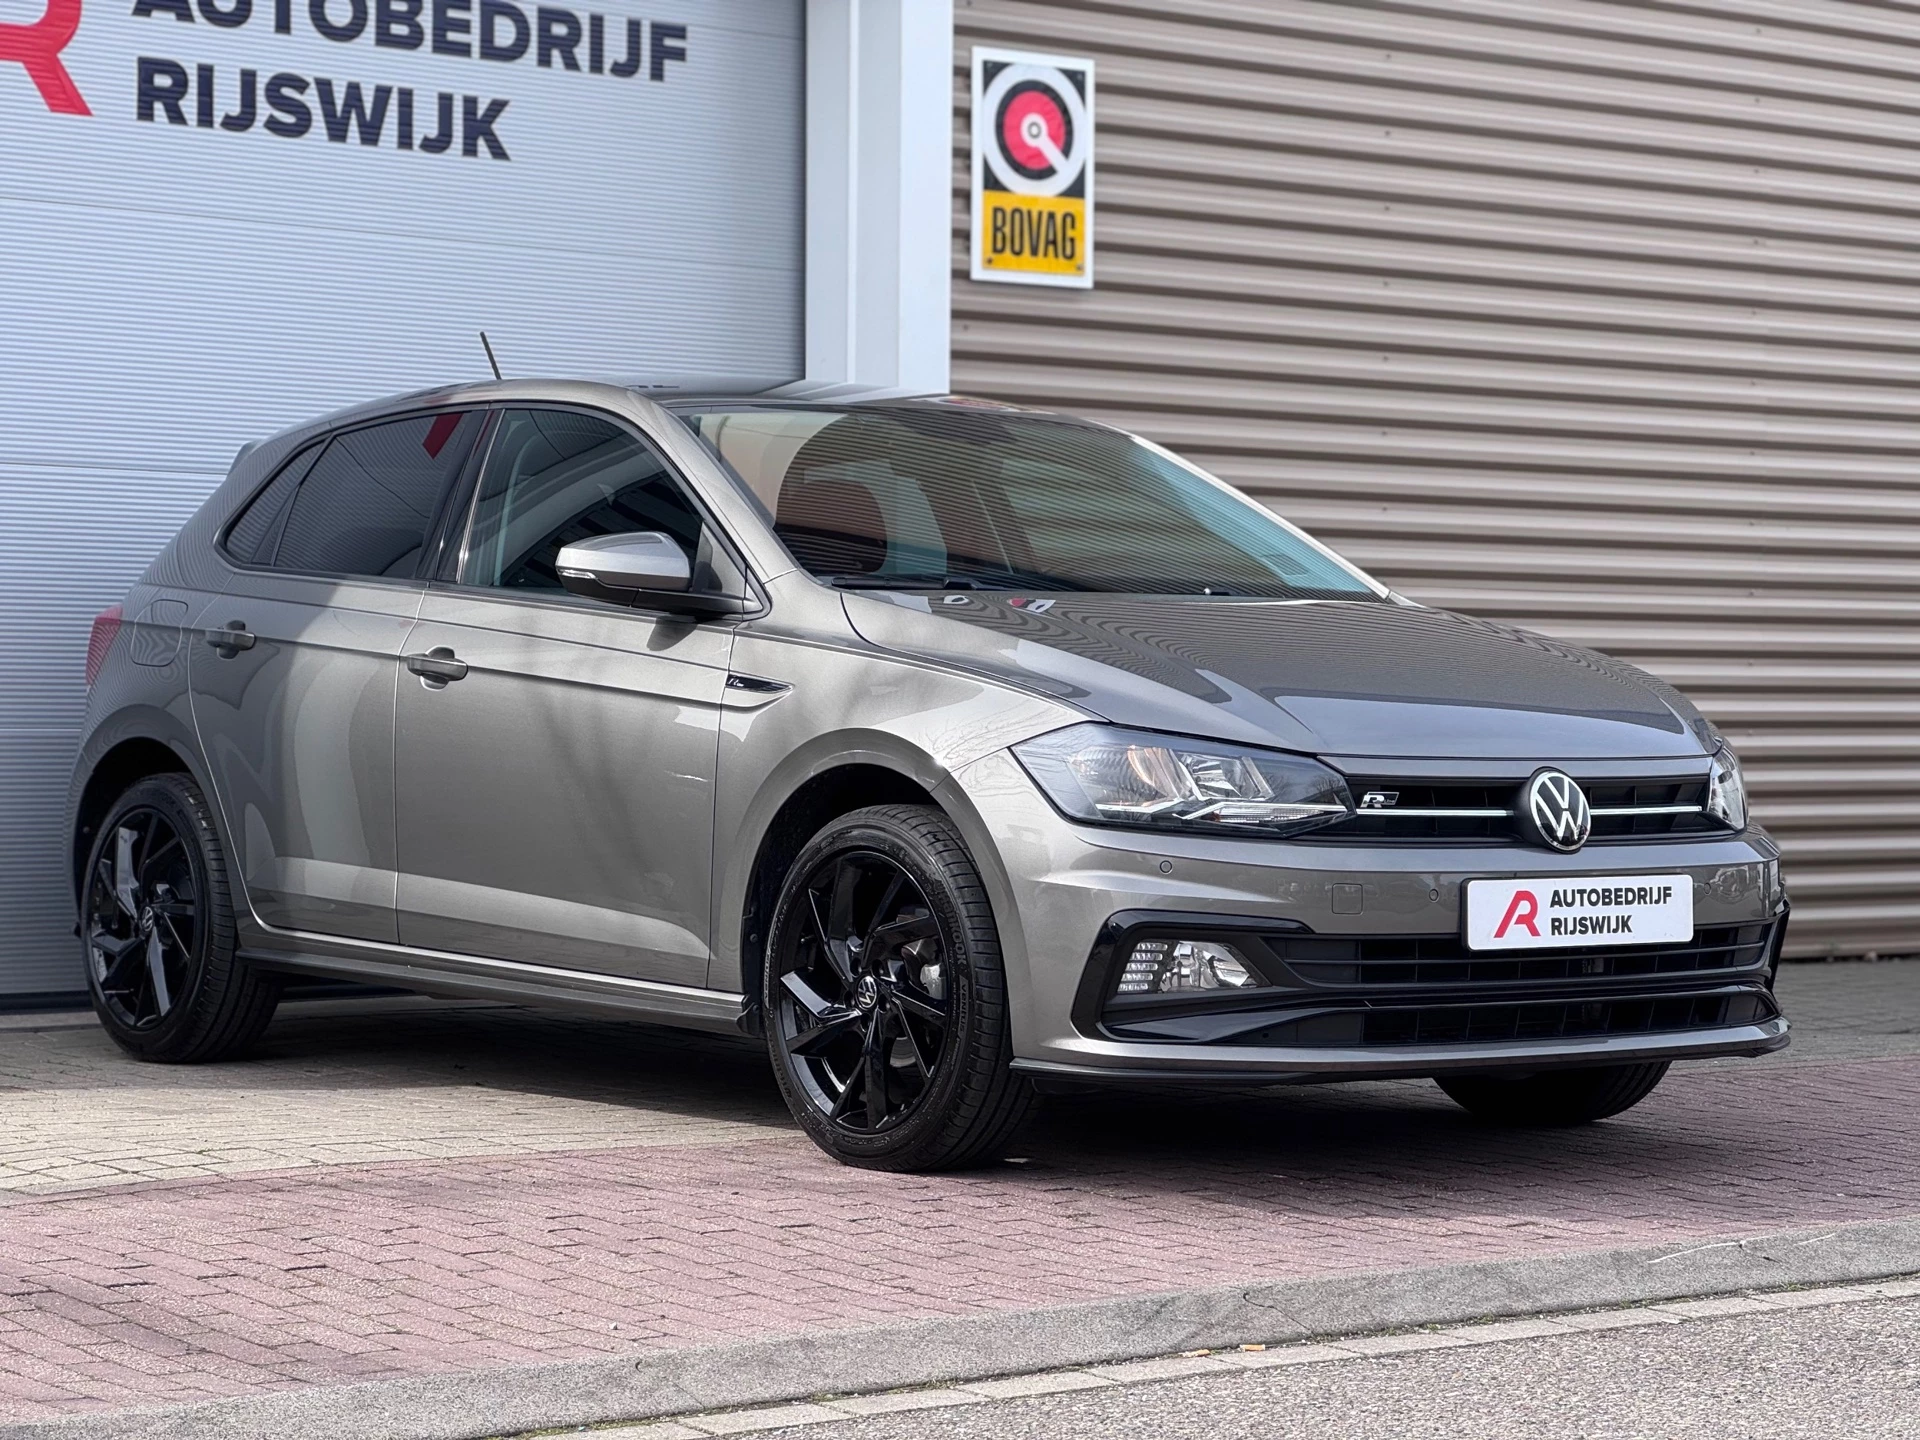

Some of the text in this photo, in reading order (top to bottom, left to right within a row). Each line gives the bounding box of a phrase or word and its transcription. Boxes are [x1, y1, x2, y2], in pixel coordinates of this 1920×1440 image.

[137, 56, 512, 162] RIJSWIJK
[992, 206, 1076, 261] BOVAG
[1549, 886, 1672, 908] AUTOBEDRIJF
[1551, 915, 1633, 936] RIJSWIJK
